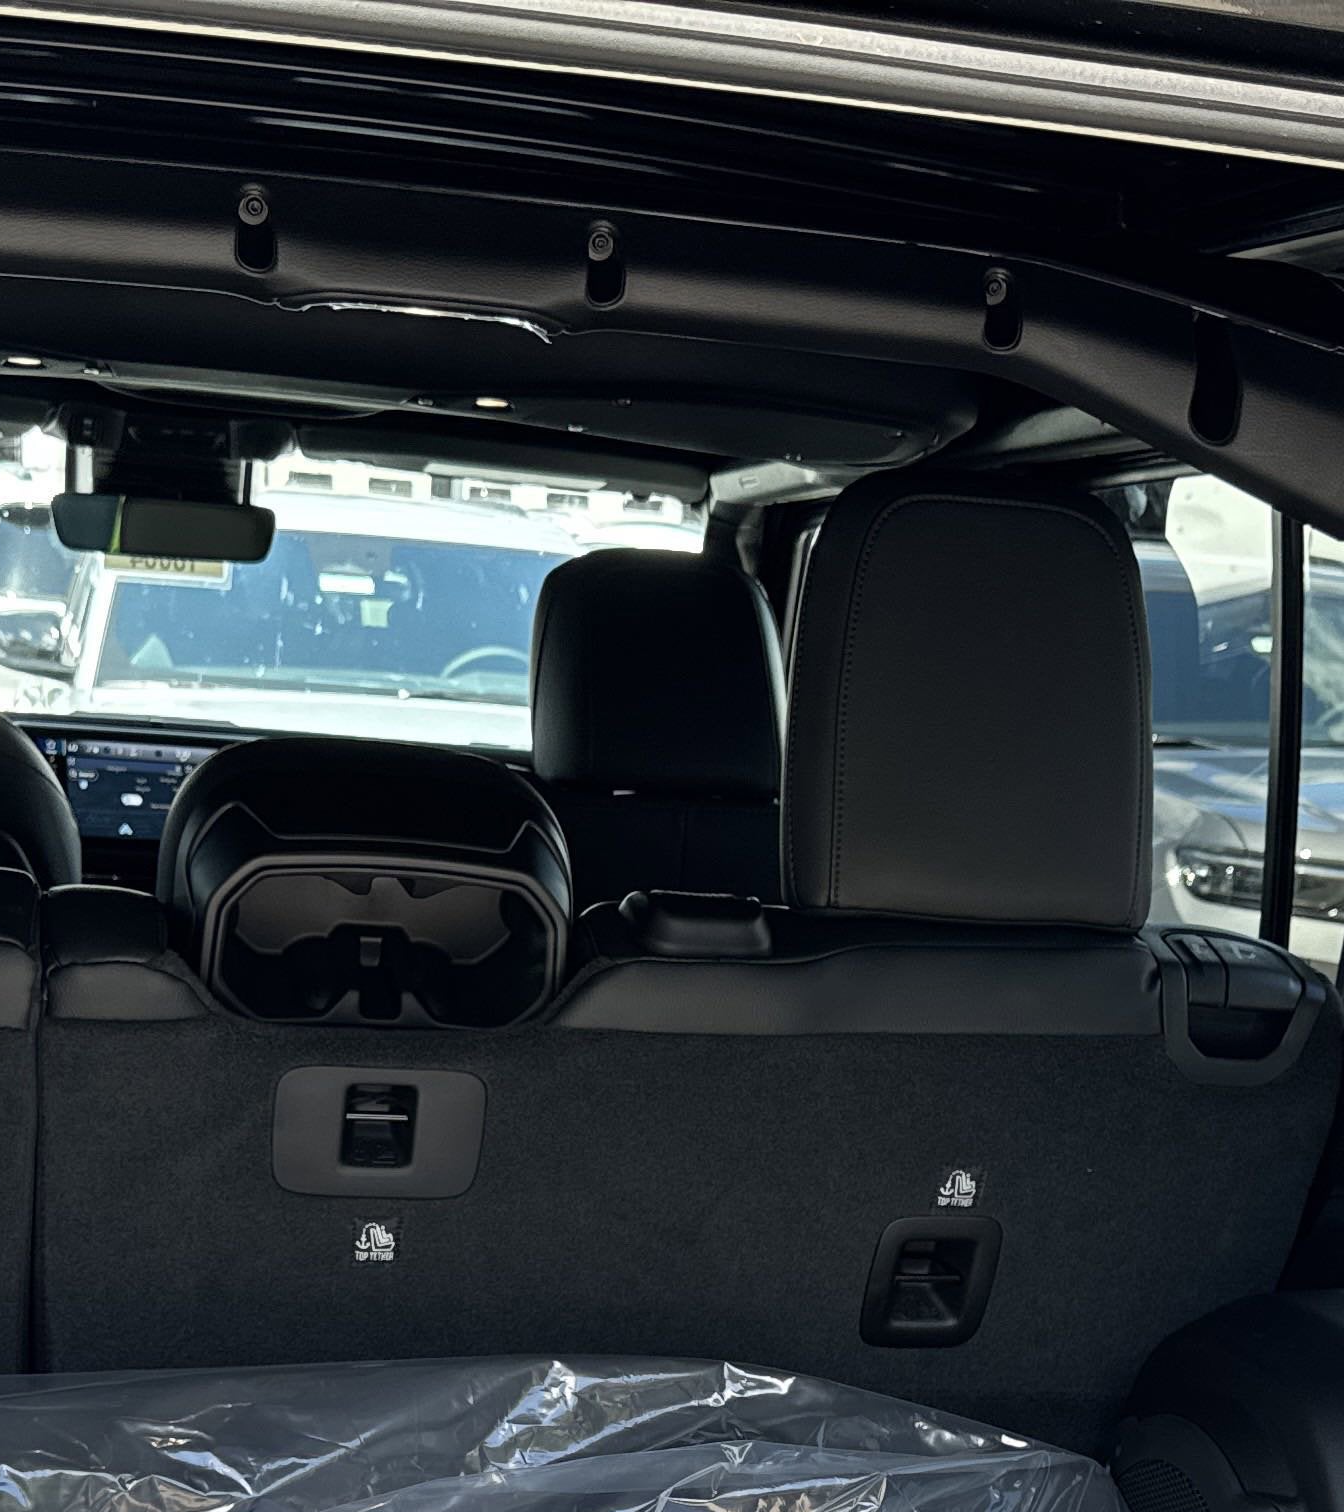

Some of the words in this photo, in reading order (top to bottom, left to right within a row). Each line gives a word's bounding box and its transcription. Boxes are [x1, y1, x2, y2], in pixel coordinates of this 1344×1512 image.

[937, 1196, 951, 1207] TOP
[950, 1196, 974, 1208] TETHER
[354, 1250, 369, 1261] TOP
[369, 1250, 394, 1261] TETHER
